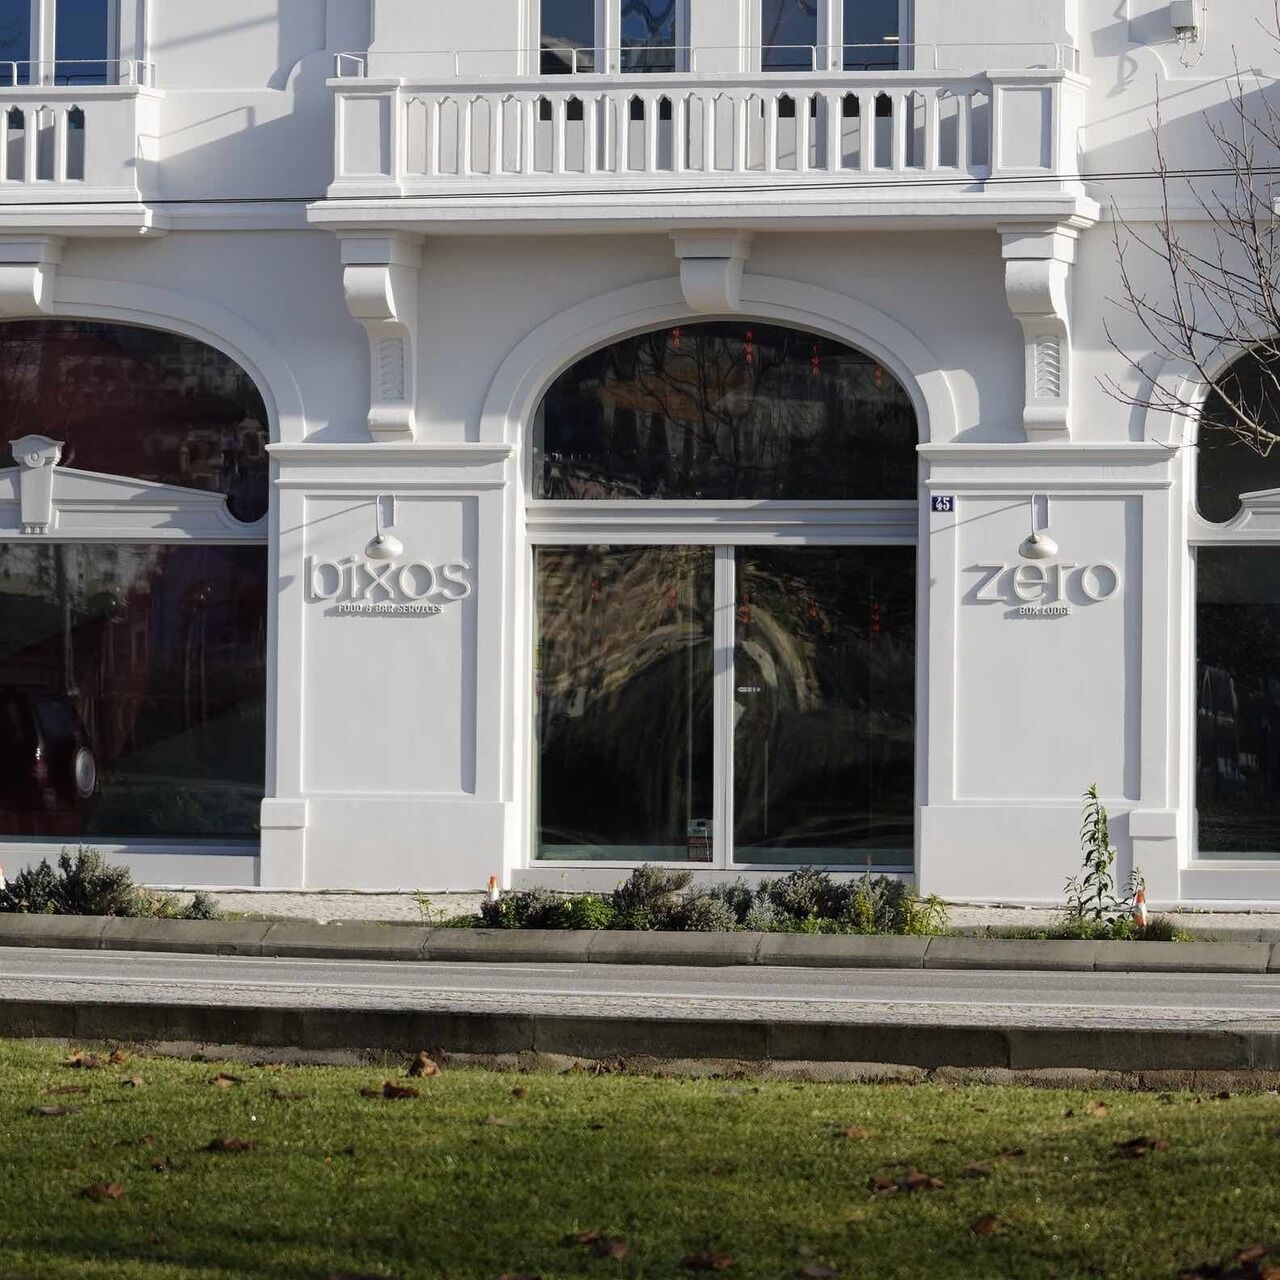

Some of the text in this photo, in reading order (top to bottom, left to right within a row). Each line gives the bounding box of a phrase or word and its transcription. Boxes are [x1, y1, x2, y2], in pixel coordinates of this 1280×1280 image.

[935, 496, 950, 511] 45
[311, 554, 471, 600] bixos
[976, 561, 1120, 601] zero
[338, 604, 362, 613] FOOD
[376, 604, 394, 613] BAR
[397, 604, 445, 614] SERVICES
[1020, 605, 1072, 615] BOX LODGE
